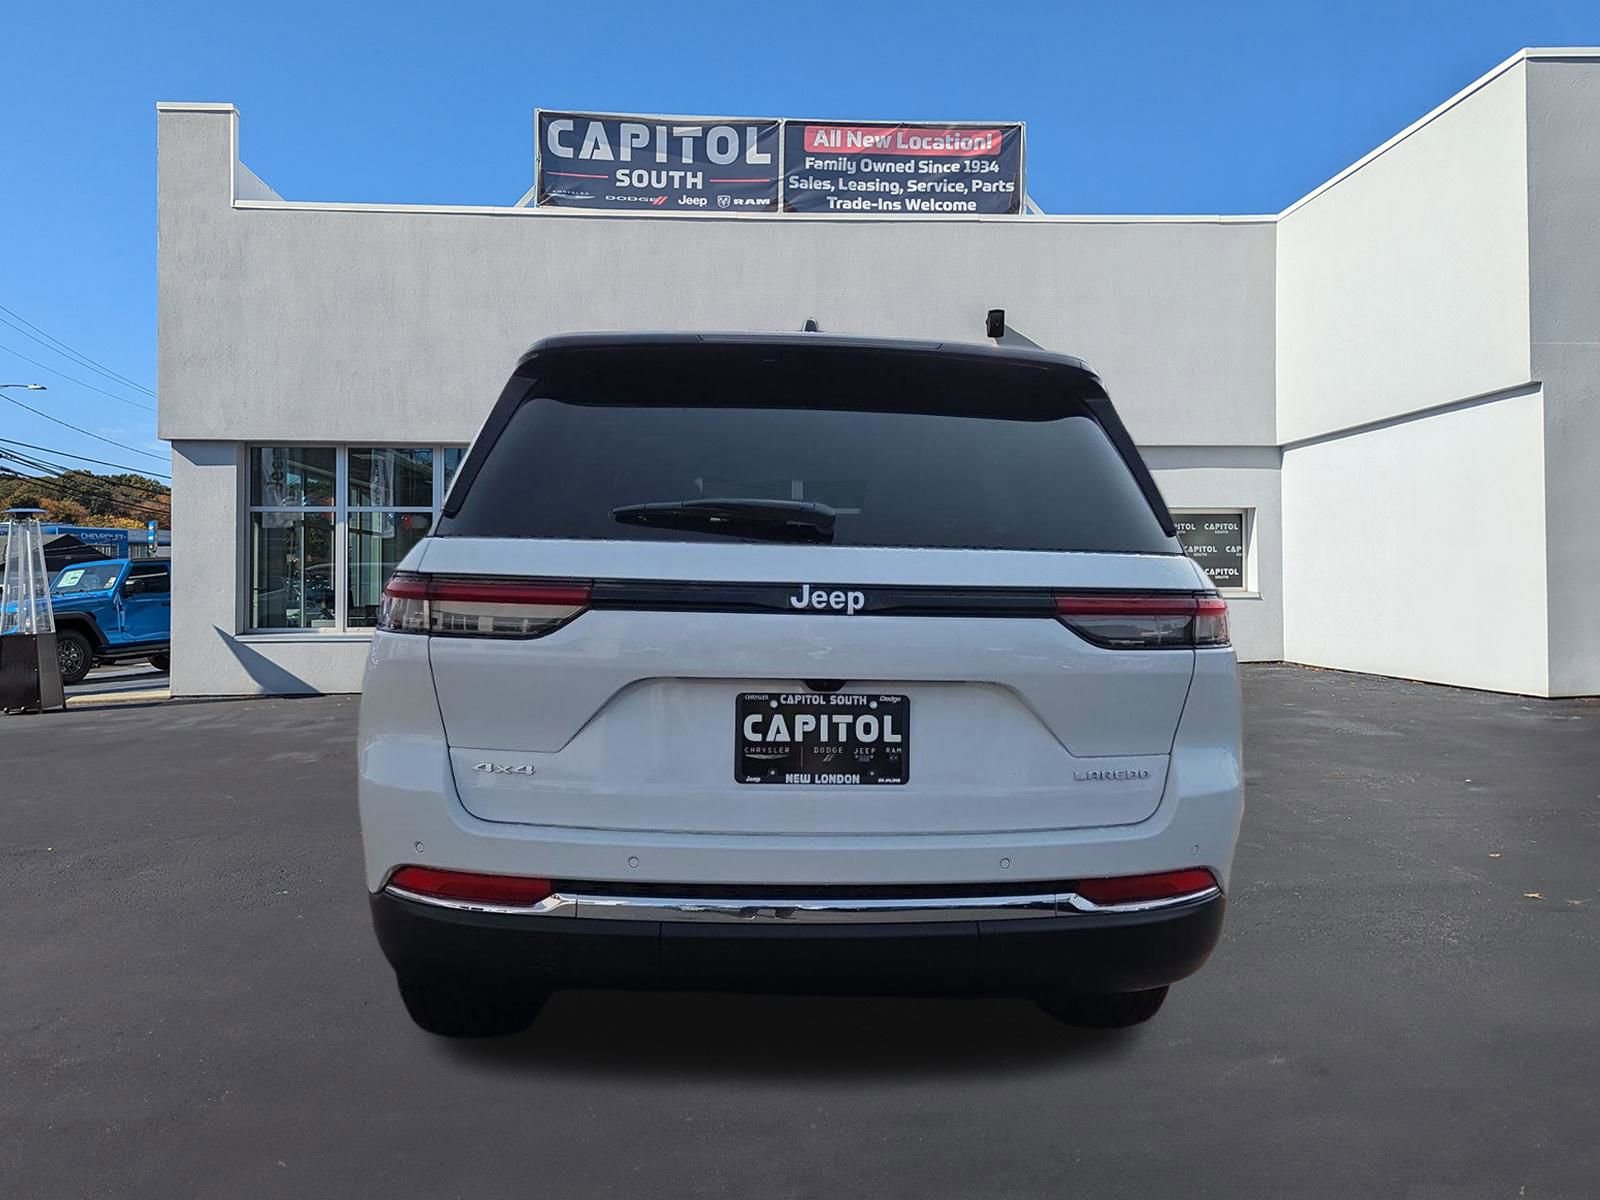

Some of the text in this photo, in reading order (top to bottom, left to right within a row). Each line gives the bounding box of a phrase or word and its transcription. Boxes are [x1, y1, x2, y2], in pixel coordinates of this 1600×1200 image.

[547, 119, 771, 165] CAPITOL
[813, 129, 993, 150] All New Location!
[805, 157, 1000, 174] Family Owned Since 1934
[615, 169, 703, 189] SOUTH
[788, 176, 1015, 195] Sales, Leasing, Service, Parts
[605, 195, 656, 203] DODGE
[678, 194, 708, 207] Jeep
[826, 196, 977, 212] Trade-Ins Welcome
[790, 584, 865, 615] Jeep
[780, 694, 867, 706] CAPITOL SOUTH
[743, 714, 902, 743] CAPITOL
[744, 746, 790, 754] CHRYSLER
[813, 746, 844, 754] DODGE
[854, 747, 876, 755] JEEP
[785, 773, 860, 784] NEW LONDON
[1073, 769, 1151, 781] LAREDO
